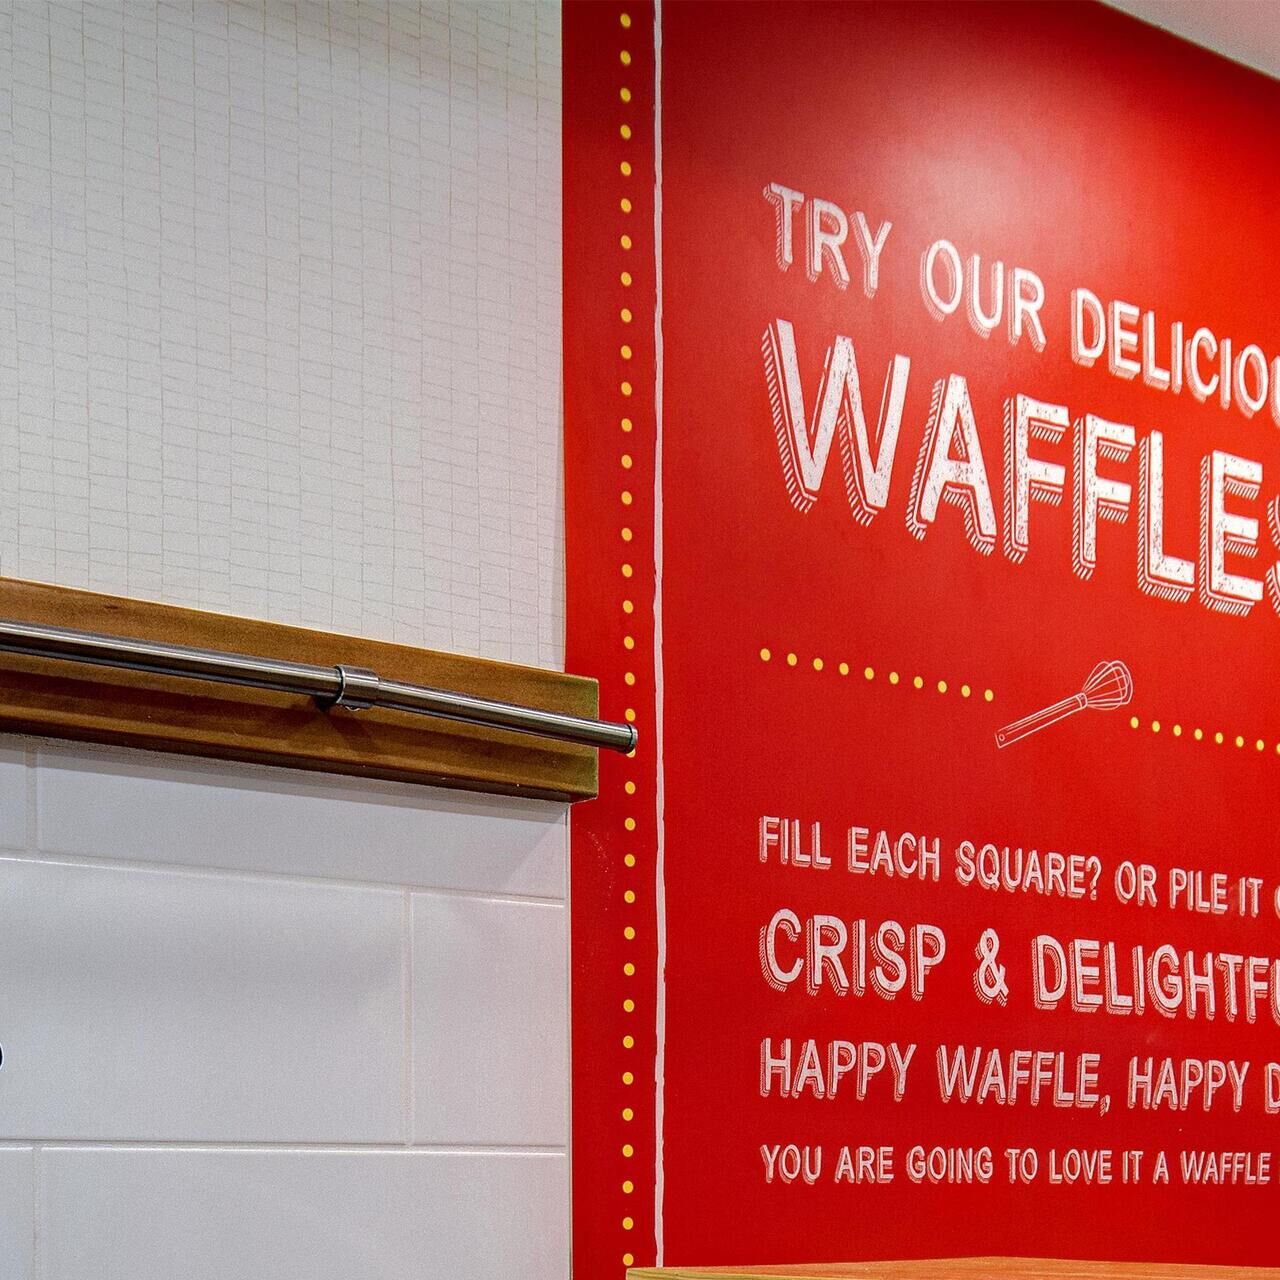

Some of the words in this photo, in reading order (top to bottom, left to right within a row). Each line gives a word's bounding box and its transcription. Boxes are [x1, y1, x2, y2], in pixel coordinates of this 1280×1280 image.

[762, 181, 892, 299] TRY
[920, 239, 1047, 353] OUR
[759, 815, 831, 868] FILL
[847, 825, 940, 881] EACH
[955, 840, 1101, 901] SQUARE?
[1114, 860, 1158, 908] OR
[1169, 867, 1228, 916] PILE
[1237, 876, 1264, 918] IT
[759, 907, 946, 1001] CRISP
[972, 928, 1009, 1008] &
[759, 1038, 918, 1100] HAPPY
[936, 1043, 1111, 1117] WAFFLE,
[1127, 1055, 1250, 1112] HAPPY
[760, 1144, 824, 1185] YOU
[835, 1146, 895, 1184] ARE
[905, 1147, 994, 1184] GOING
[1006, 1148, 1040, 1183] TO
[1048, 1149, 1113, 1184] LOVE
[1121, 1150, 1145, 1184] IT
[1152, 1152, 1170, 1184] A
[1179, 1152, 1272, 1185] WAFFLE
